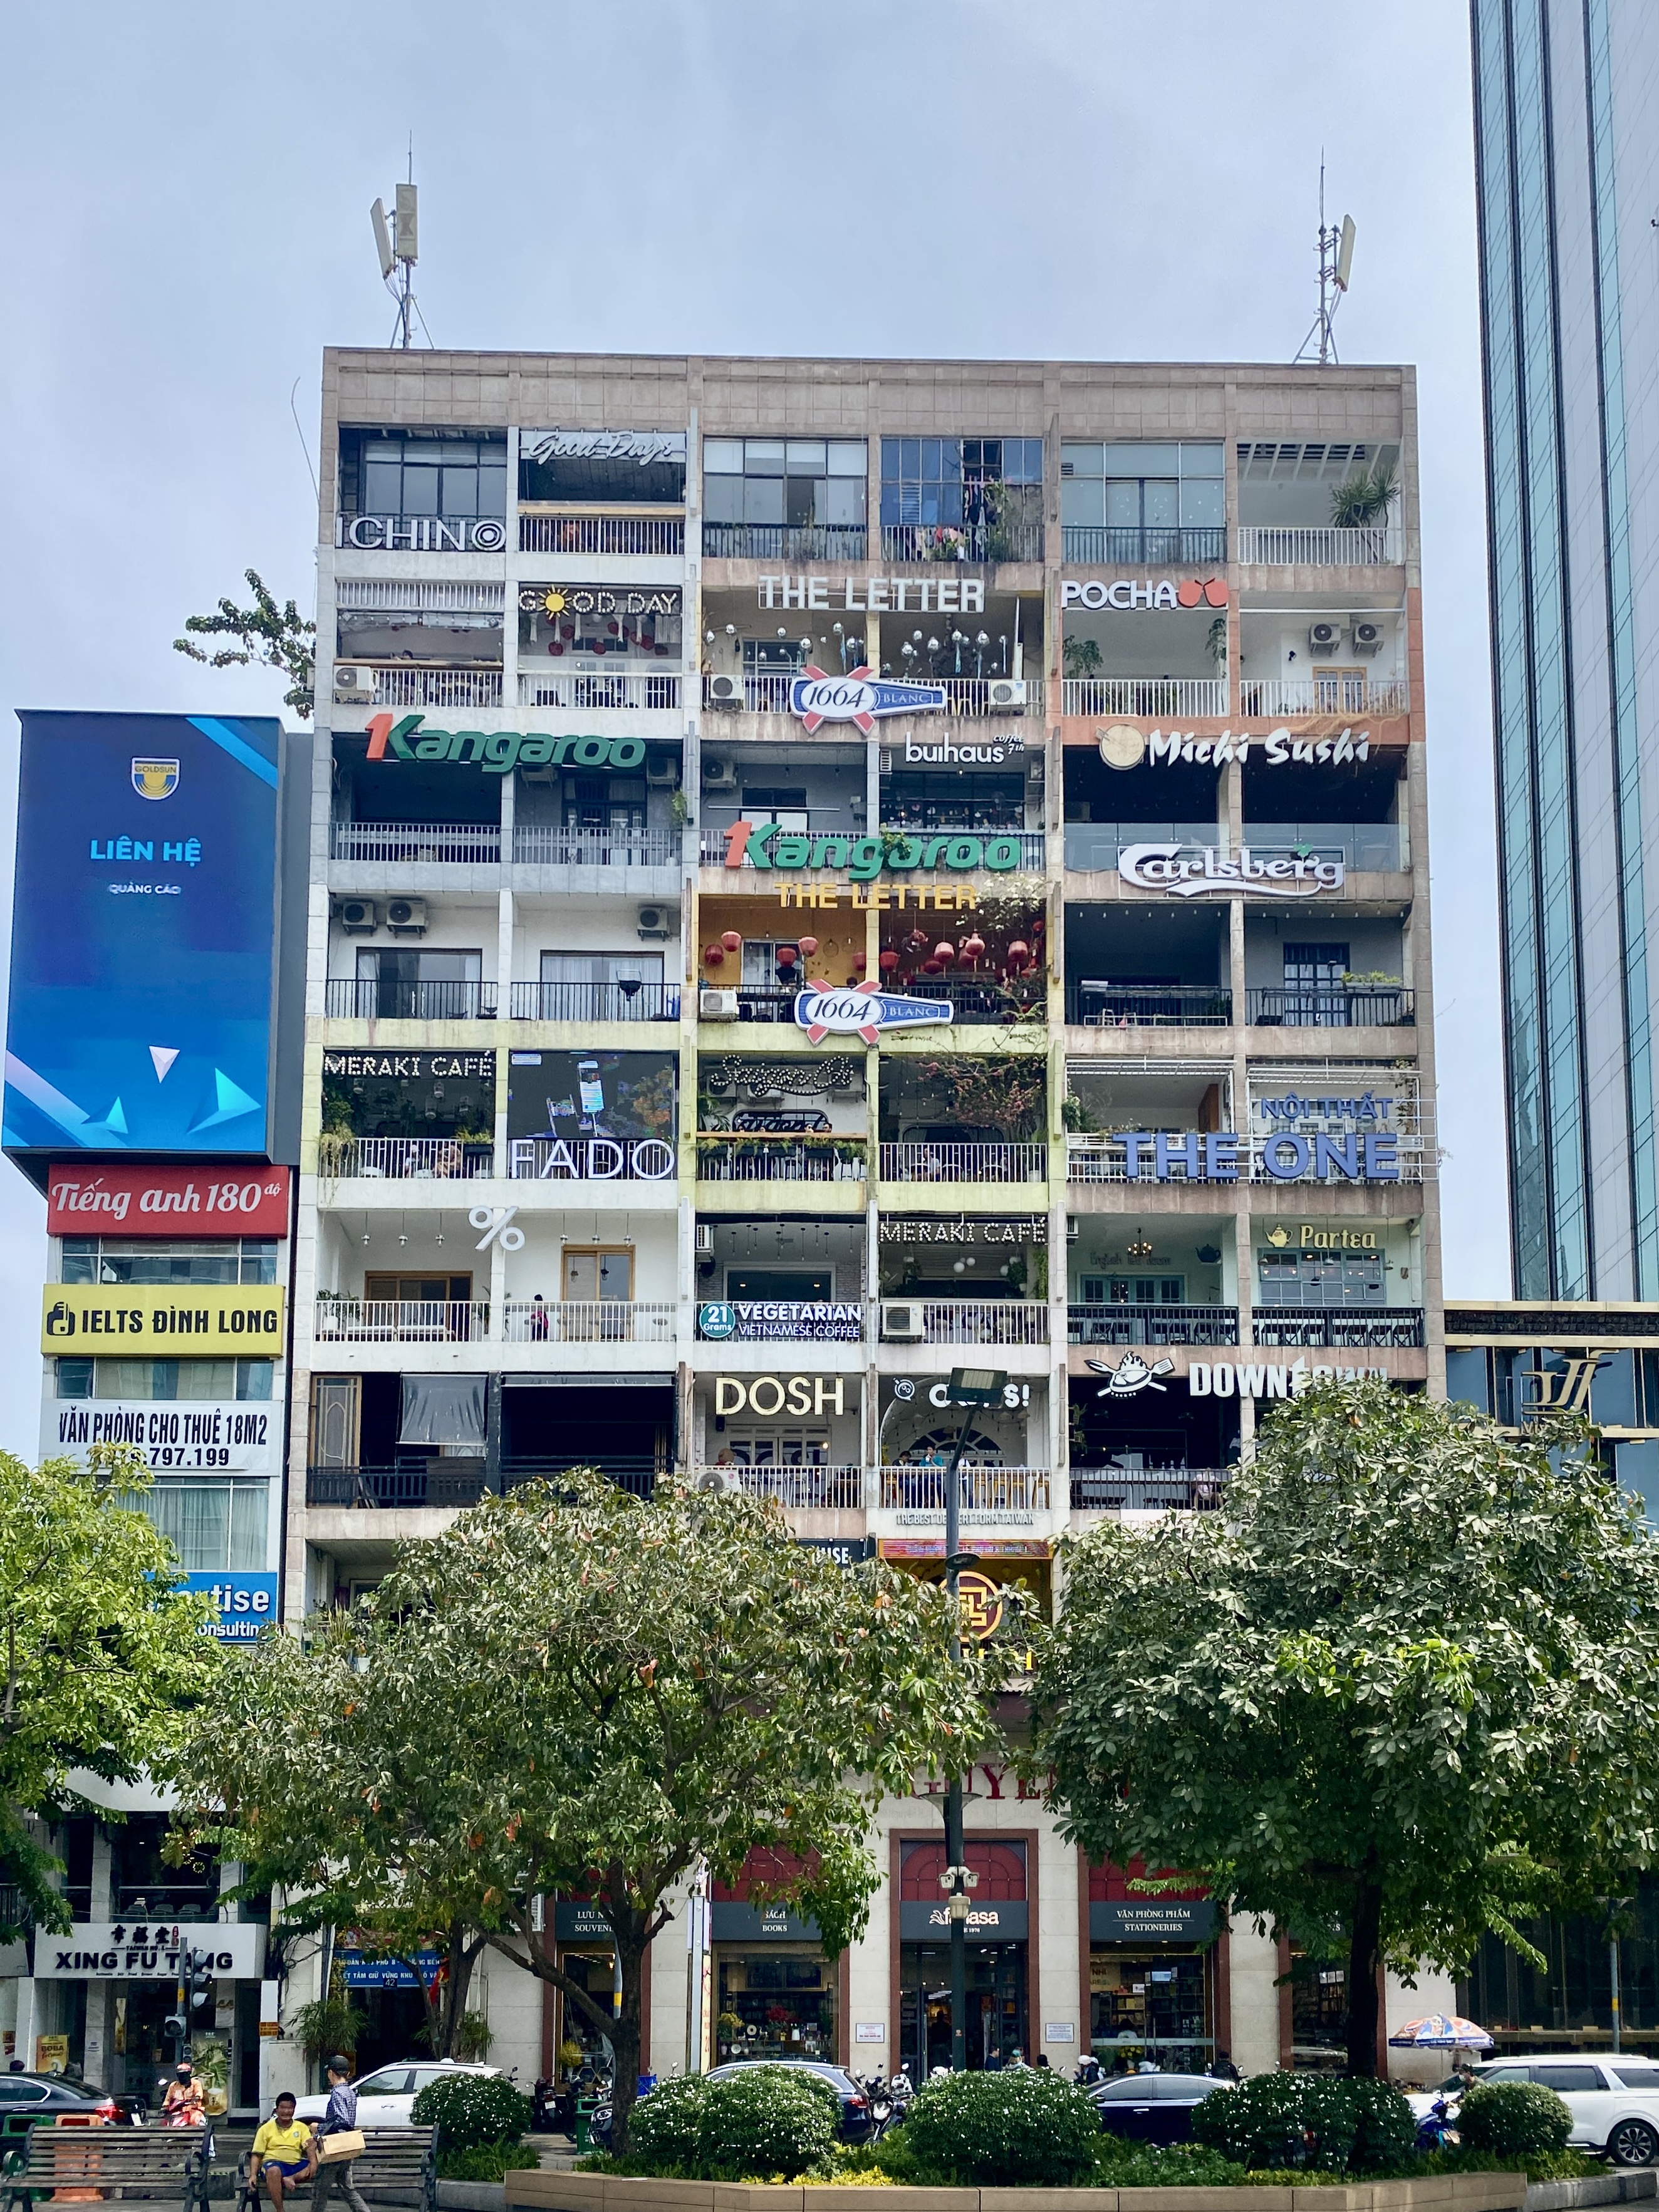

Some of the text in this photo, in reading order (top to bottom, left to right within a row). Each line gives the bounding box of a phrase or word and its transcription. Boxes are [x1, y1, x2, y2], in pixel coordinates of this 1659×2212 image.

[529, 431, 672, 467] Good Days
[627, 591, 677, 615] DAY
[759, 576, 985, 613] THE LETTER
[1061, 580, 1178, 610] POCHA
[808, 685, 868, 709] 1664
[883, 693, 930, 705] BLANC
[993, 734, 1024, 744] coffee
[1008, 743, 1024, 755] 7th
[1149, 727, 1370, 767] Michi Sushi
[135, 764, 177, 774] GOLDSUN
[90, 836, 202, 868] LIÊN HỆ
[1118, 842, 1346, 898] Carlsberg
[774, 882, 977, 910] THE LETTER
[813, 996, 874, 1019] 1664
[888, 1005, 935, 1017] BLANC
[324, 1055, 421, 1077] MERAKI
[430, 1050, 493, 1077] CAFÉ
[1261, 1090, 1394, 1123] NỘI THẤT
[511, 1139, 675, 1180] FADO
[1113, 1132, 1400, 1180] THE ONE
[51, 1178, 283, 1221] Tiếng anh 180 độ
[879, 1222, 975, 1244] MERAKI
[82, 1305, 278, 1334] IELTS ĐÌNH LONG
[707, 1305, 729, 1323] 21
[737, 1304, 862, 1322] VEGETARIAN
[703, 1322, 732, 1332] Grams
[739, 1324, 860, 1338] VIETNAMESE COFFEE
[715, 1376, 844, 1416] DOSH
[928, 1383, 1029, 1408] OS!
[60, 1406, 268, 1445] VĂN PHÒNG CHO THUÊ 18M2
[897, 1514, 1034, 1526] THE BEST DEERT FORM TAIWAN
[577, 1911, 595, 1919] LƯU
[944, 1907, 999, 1925] fasa
[1116, 1909, 1133, 1918] VĂN
[1136, 1909, 1163, 1918] PHÒNG
[55, 1952, 233, 1970] XING FU TG
[385, 1978, 395, 1986] 42
